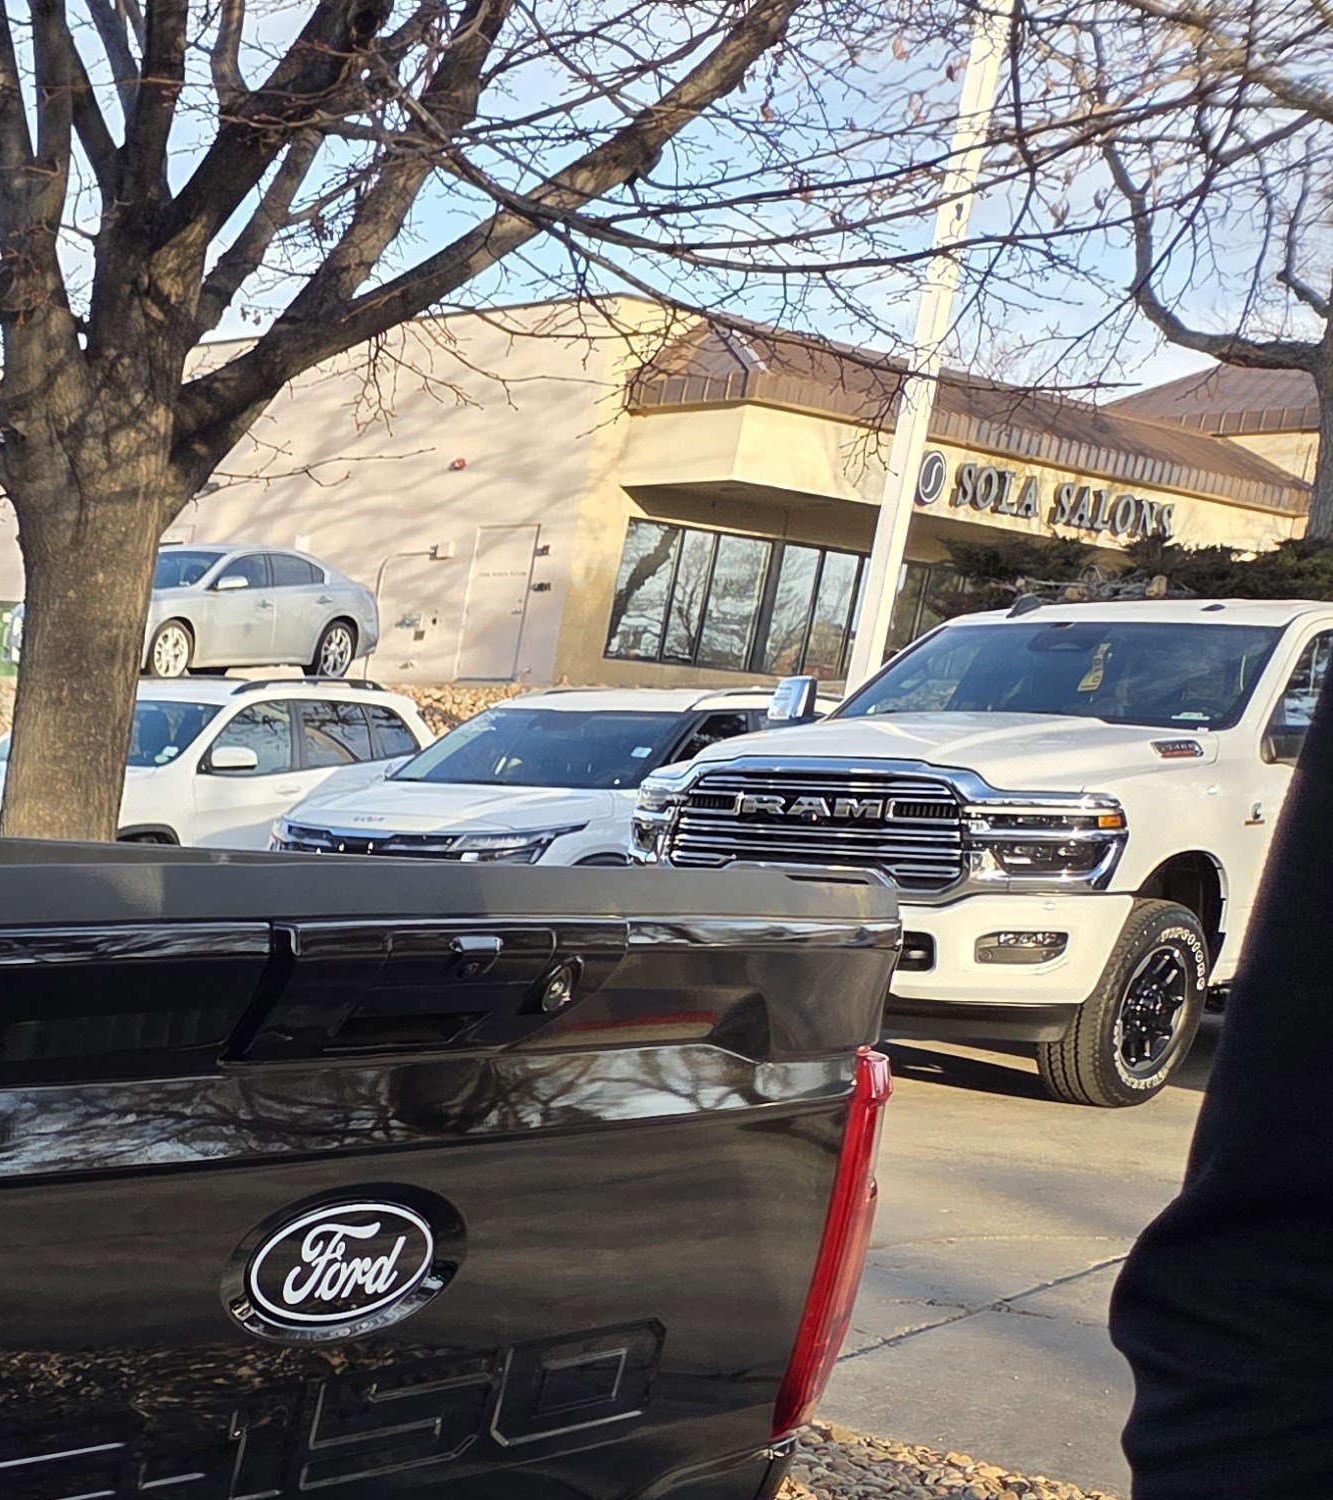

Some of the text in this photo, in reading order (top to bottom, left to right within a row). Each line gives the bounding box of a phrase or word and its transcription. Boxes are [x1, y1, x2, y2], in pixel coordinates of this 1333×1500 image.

[950, 462, 1175, 537] SOLA SALONS
[742, 794, 884, 819] RAM
[283, 1221, 407, 1305] Ford
